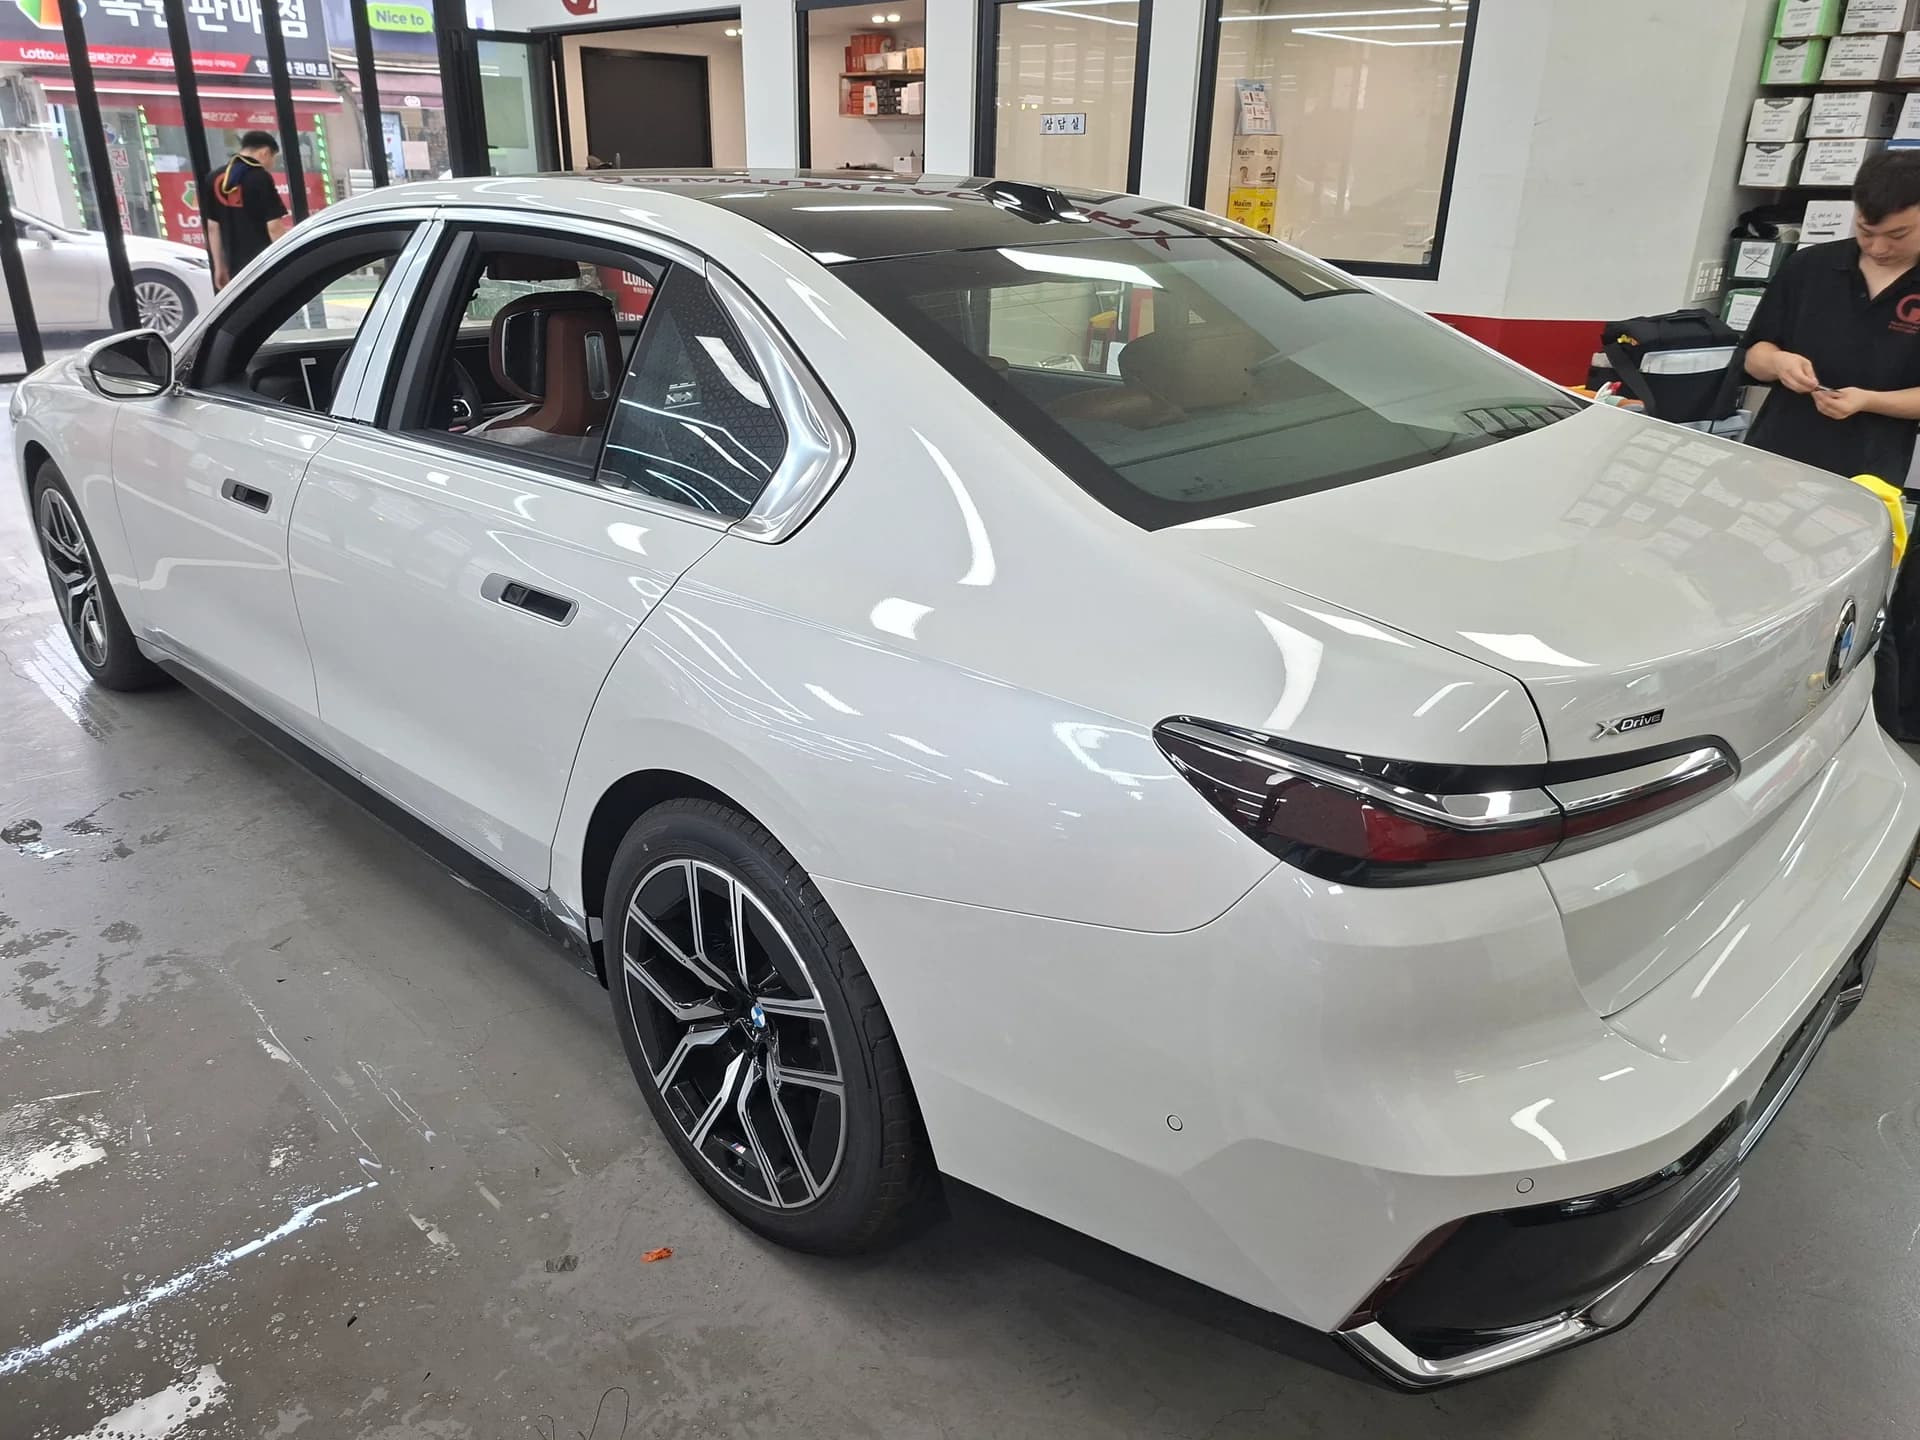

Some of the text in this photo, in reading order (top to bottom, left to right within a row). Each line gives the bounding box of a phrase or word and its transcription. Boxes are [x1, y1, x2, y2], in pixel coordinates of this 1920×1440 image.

[376, 10, 424, 25] Nice to
[20, 47, 55, 60] Lotto
